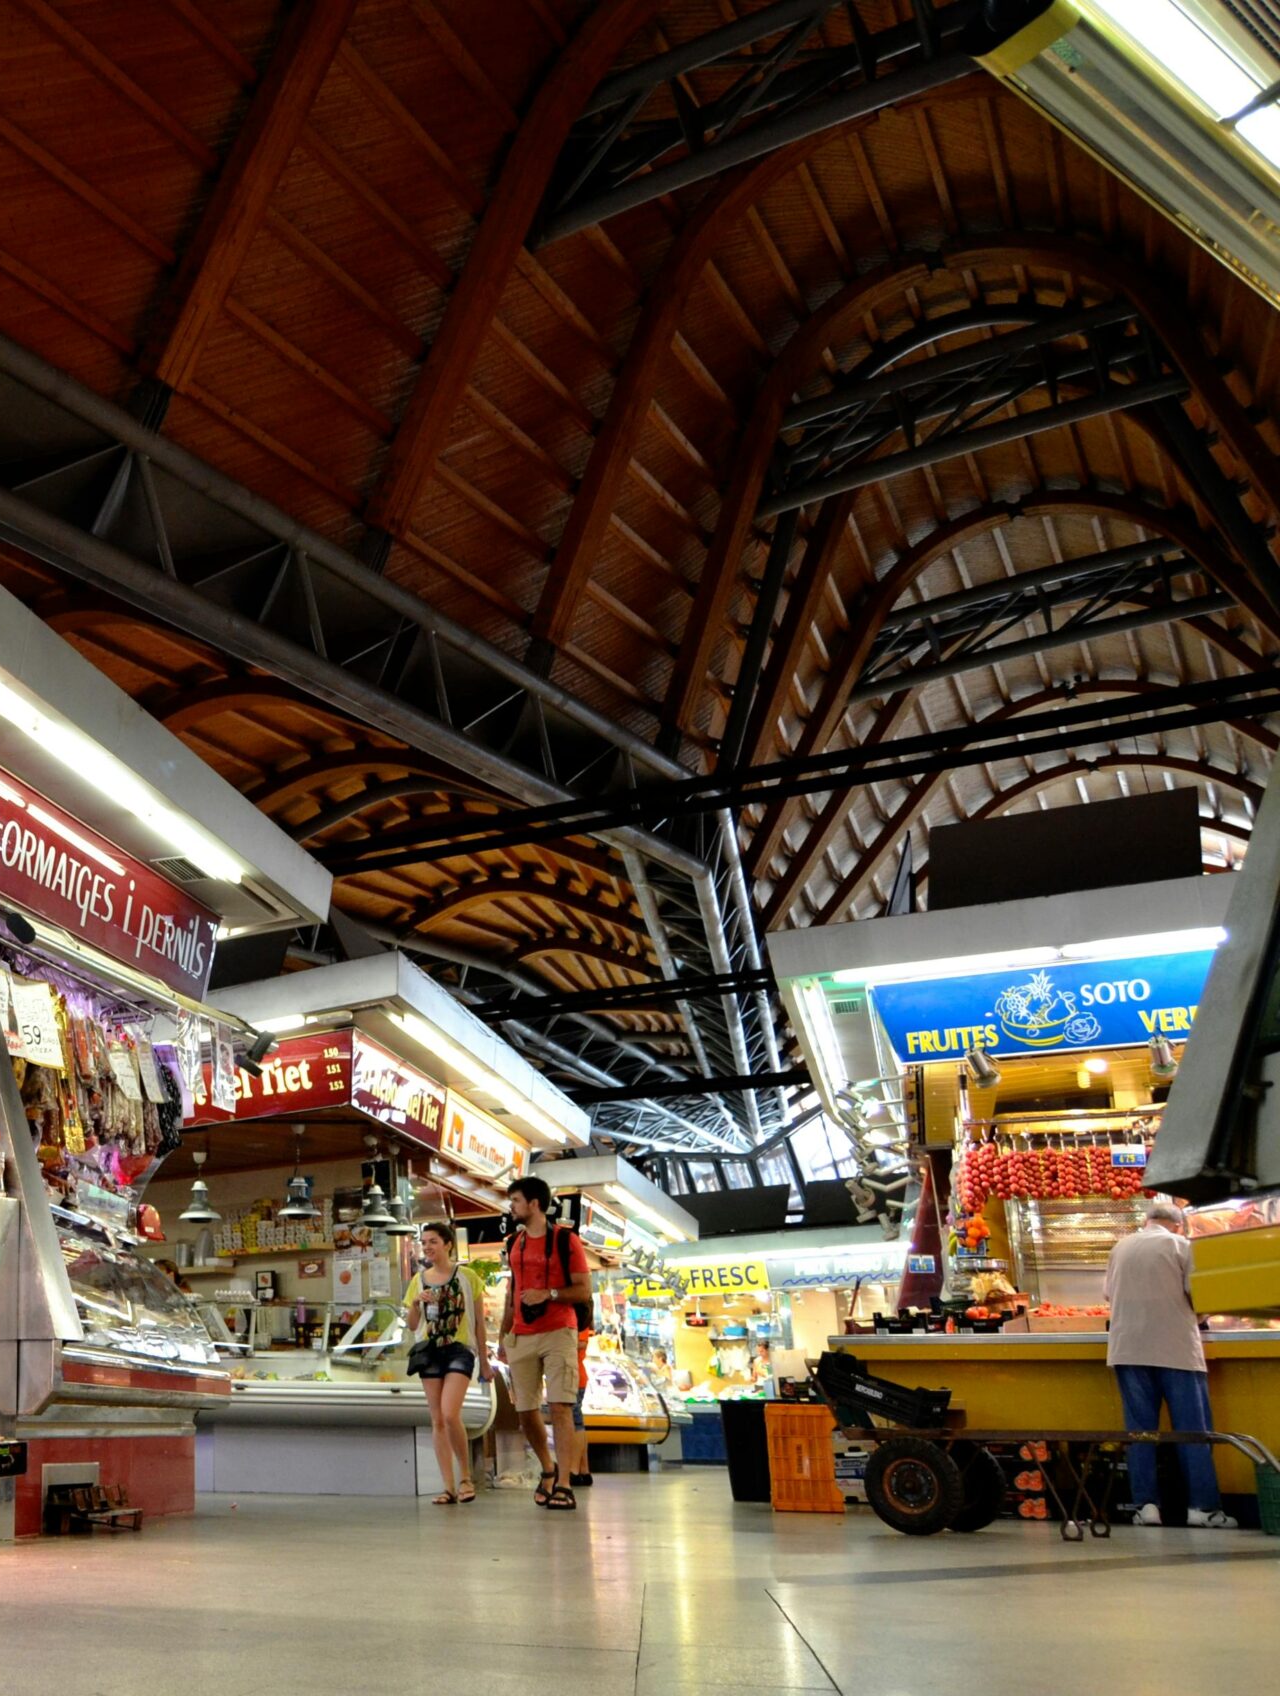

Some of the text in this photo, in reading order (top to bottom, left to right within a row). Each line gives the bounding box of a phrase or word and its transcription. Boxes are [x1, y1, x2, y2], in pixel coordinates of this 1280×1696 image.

[1080, 978, 1151, 1006] SOTO
[907, 1023, 1000, 1055] FRUITES
[323, 1047, 339, 1058] 150
[258, 1056, 314, 1097] Tiet
[326, 1064, 341, 1075] 151
[329, 1080, 344, 1091] 152
[690, 1265, 759, 1289] FRESC
